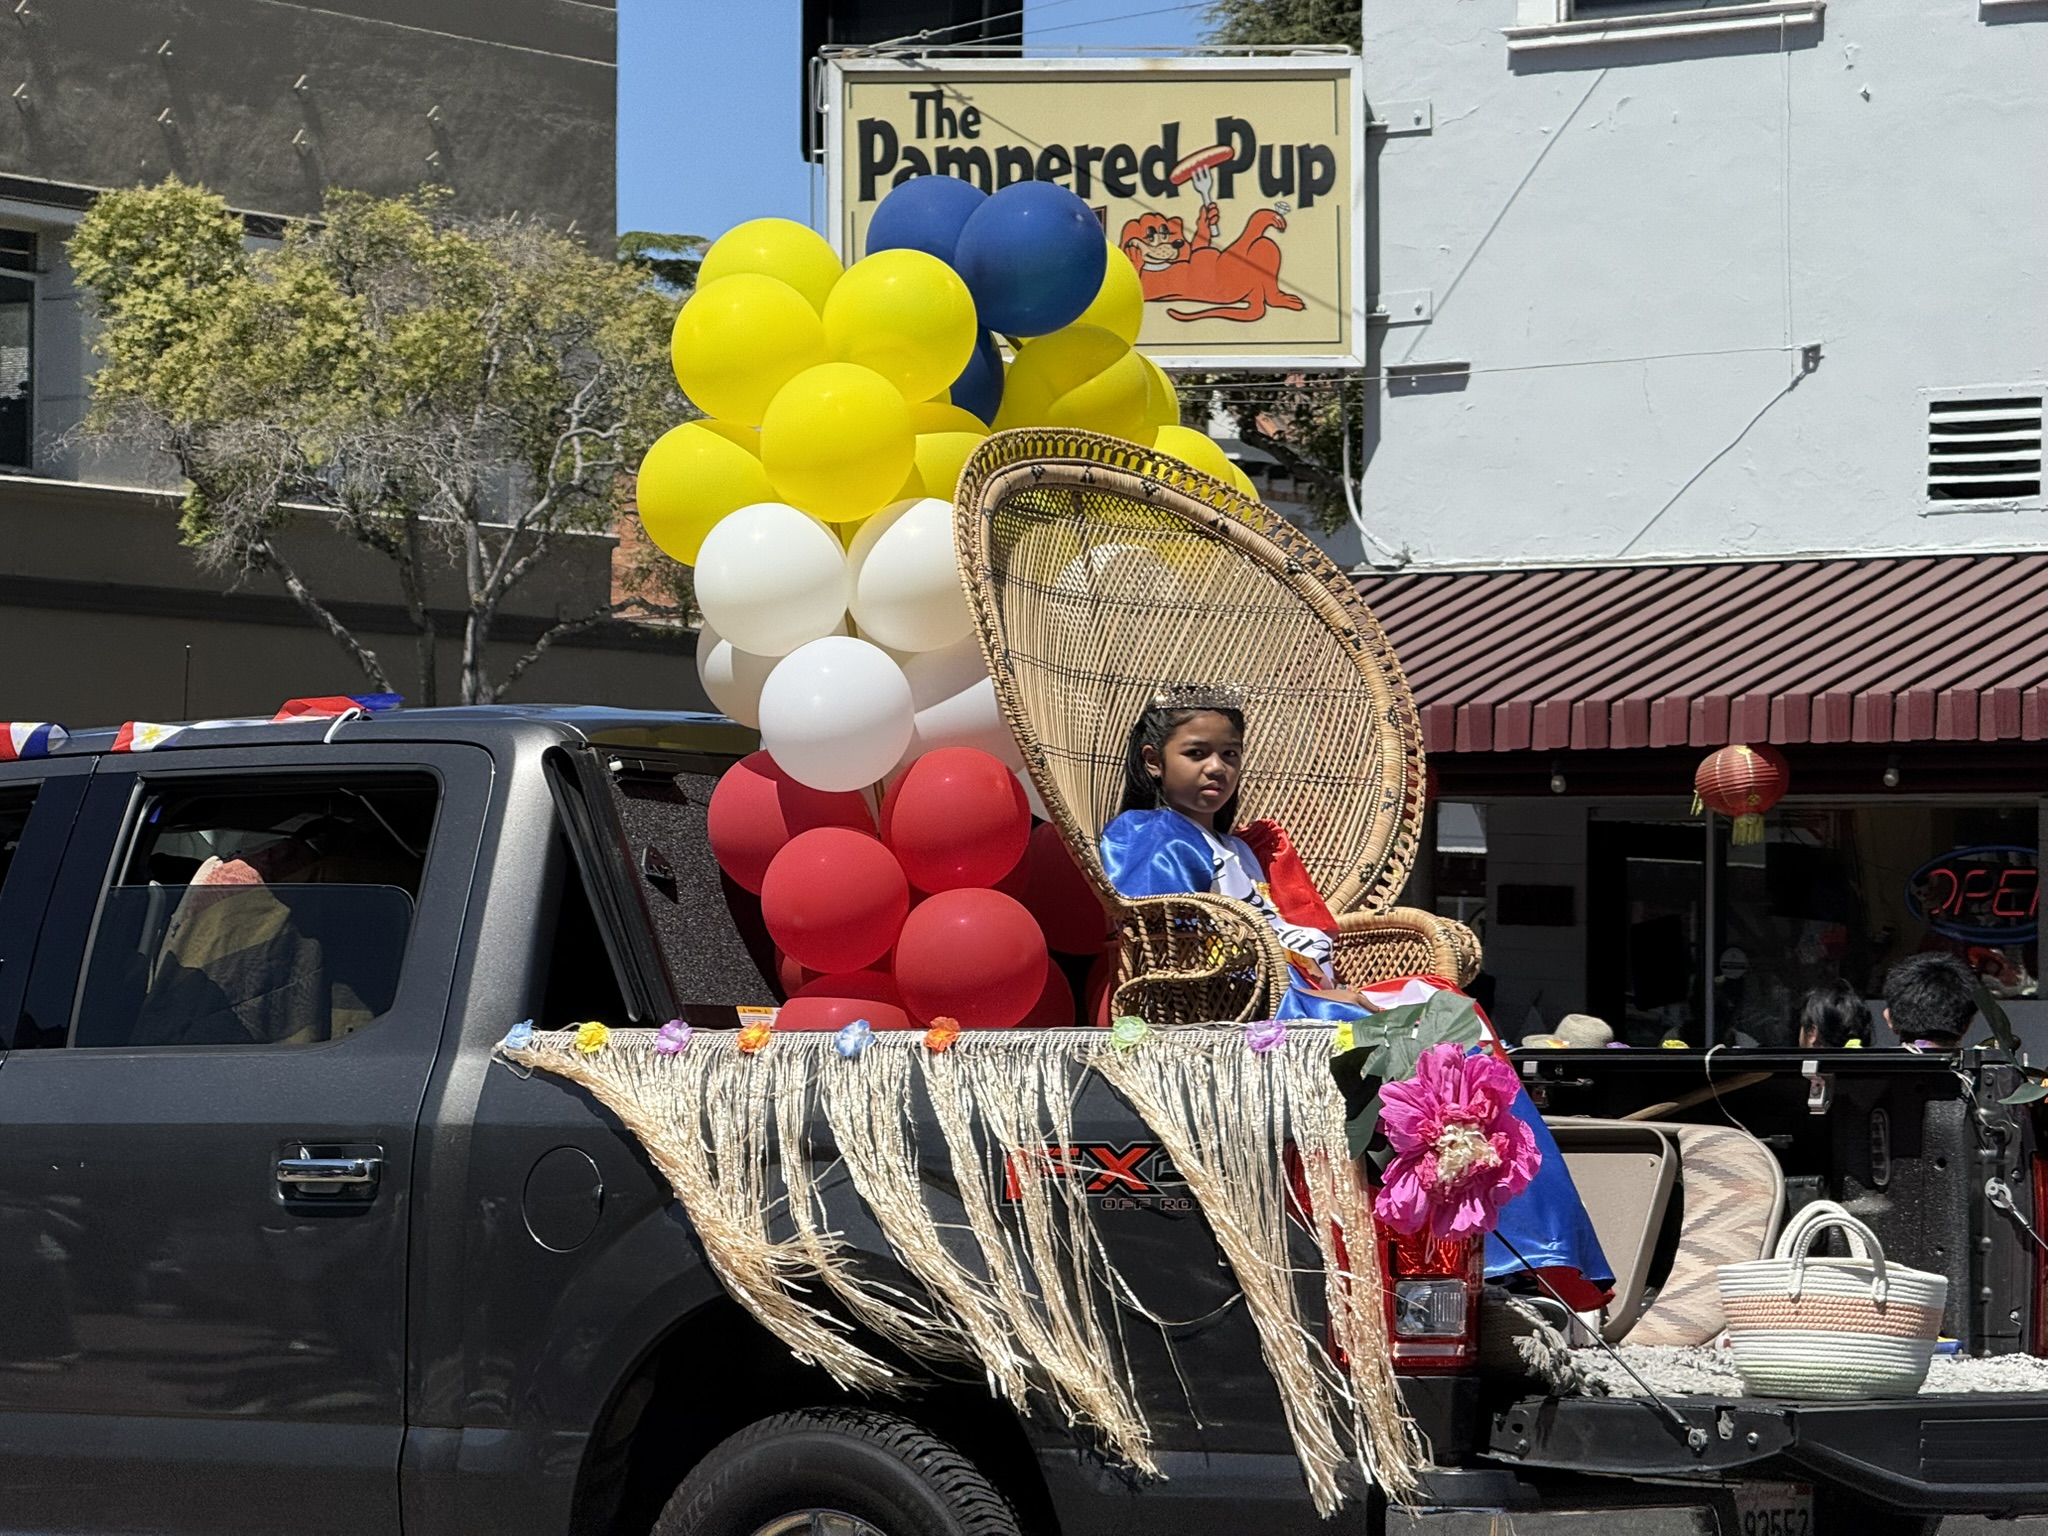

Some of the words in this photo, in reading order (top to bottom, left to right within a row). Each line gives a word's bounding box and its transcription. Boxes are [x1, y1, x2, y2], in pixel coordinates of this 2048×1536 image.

[909, 89, 982, 140] The
[857, 117, 1180, 202] Pampered
[1215, 116, 1337, 209] Pup
[1929, 868, 2040, 916] OPE
[1101, 1198, 1152, 1211] OFF
[1159, 1198, 1201, 1211] RO
